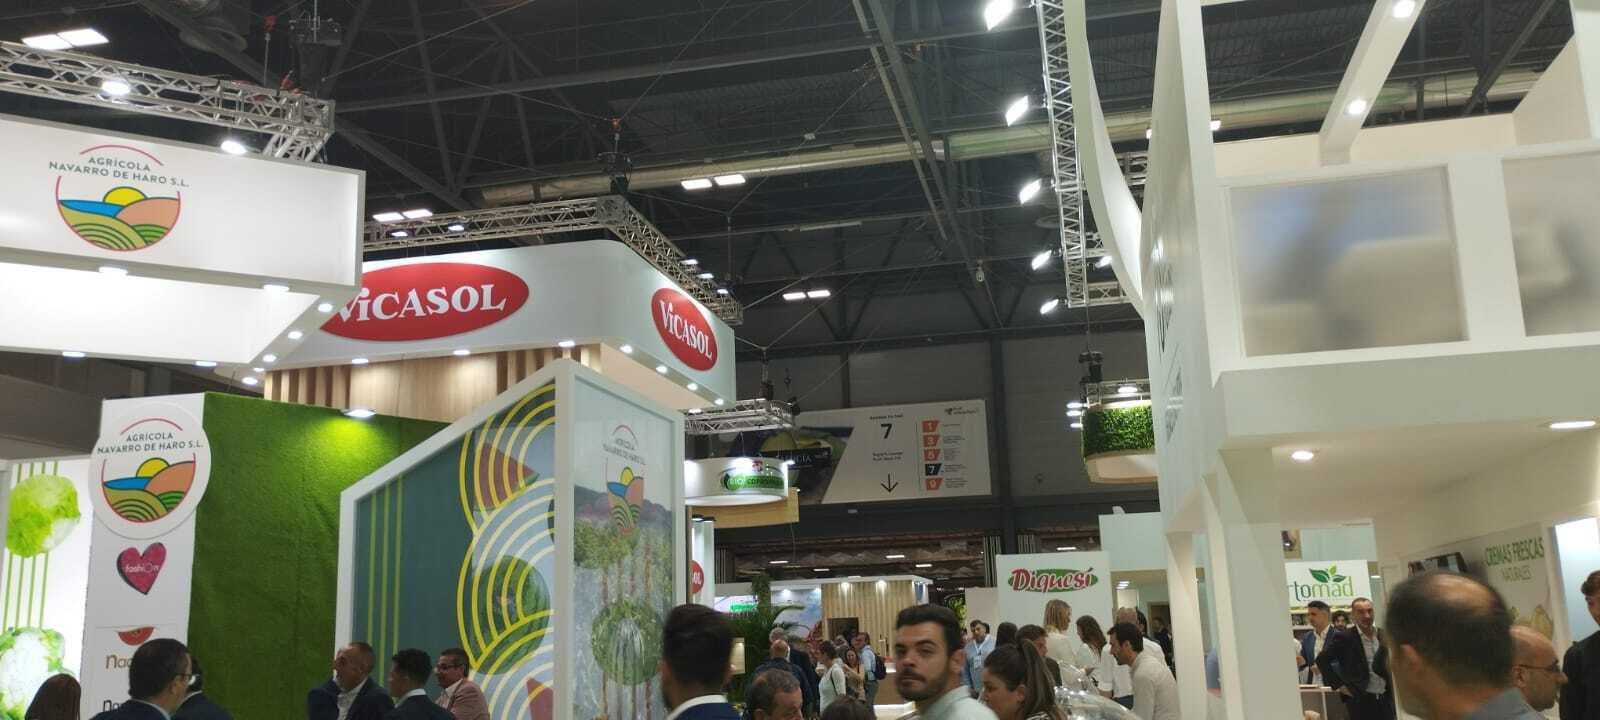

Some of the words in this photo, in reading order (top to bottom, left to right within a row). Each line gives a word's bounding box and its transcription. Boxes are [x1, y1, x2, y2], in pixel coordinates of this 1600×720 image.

[48, 161, 110, 177] NAVARRO
[112, 169, 130, 180] DE
[132, 172, 168, 185] HARO
[169, 177, 190, 188] S.L.
[880, 423, 893, 440] 7
[97, 443, 142, 454] NAVARRO
[143, 442, 158, 452] DE
[159, 440, 186, 450] HARO
[187, 439, 204, 449] S.L.
[928, 465, 936, 474] 7
[1011, 565, 1095, 593] Diquesí
